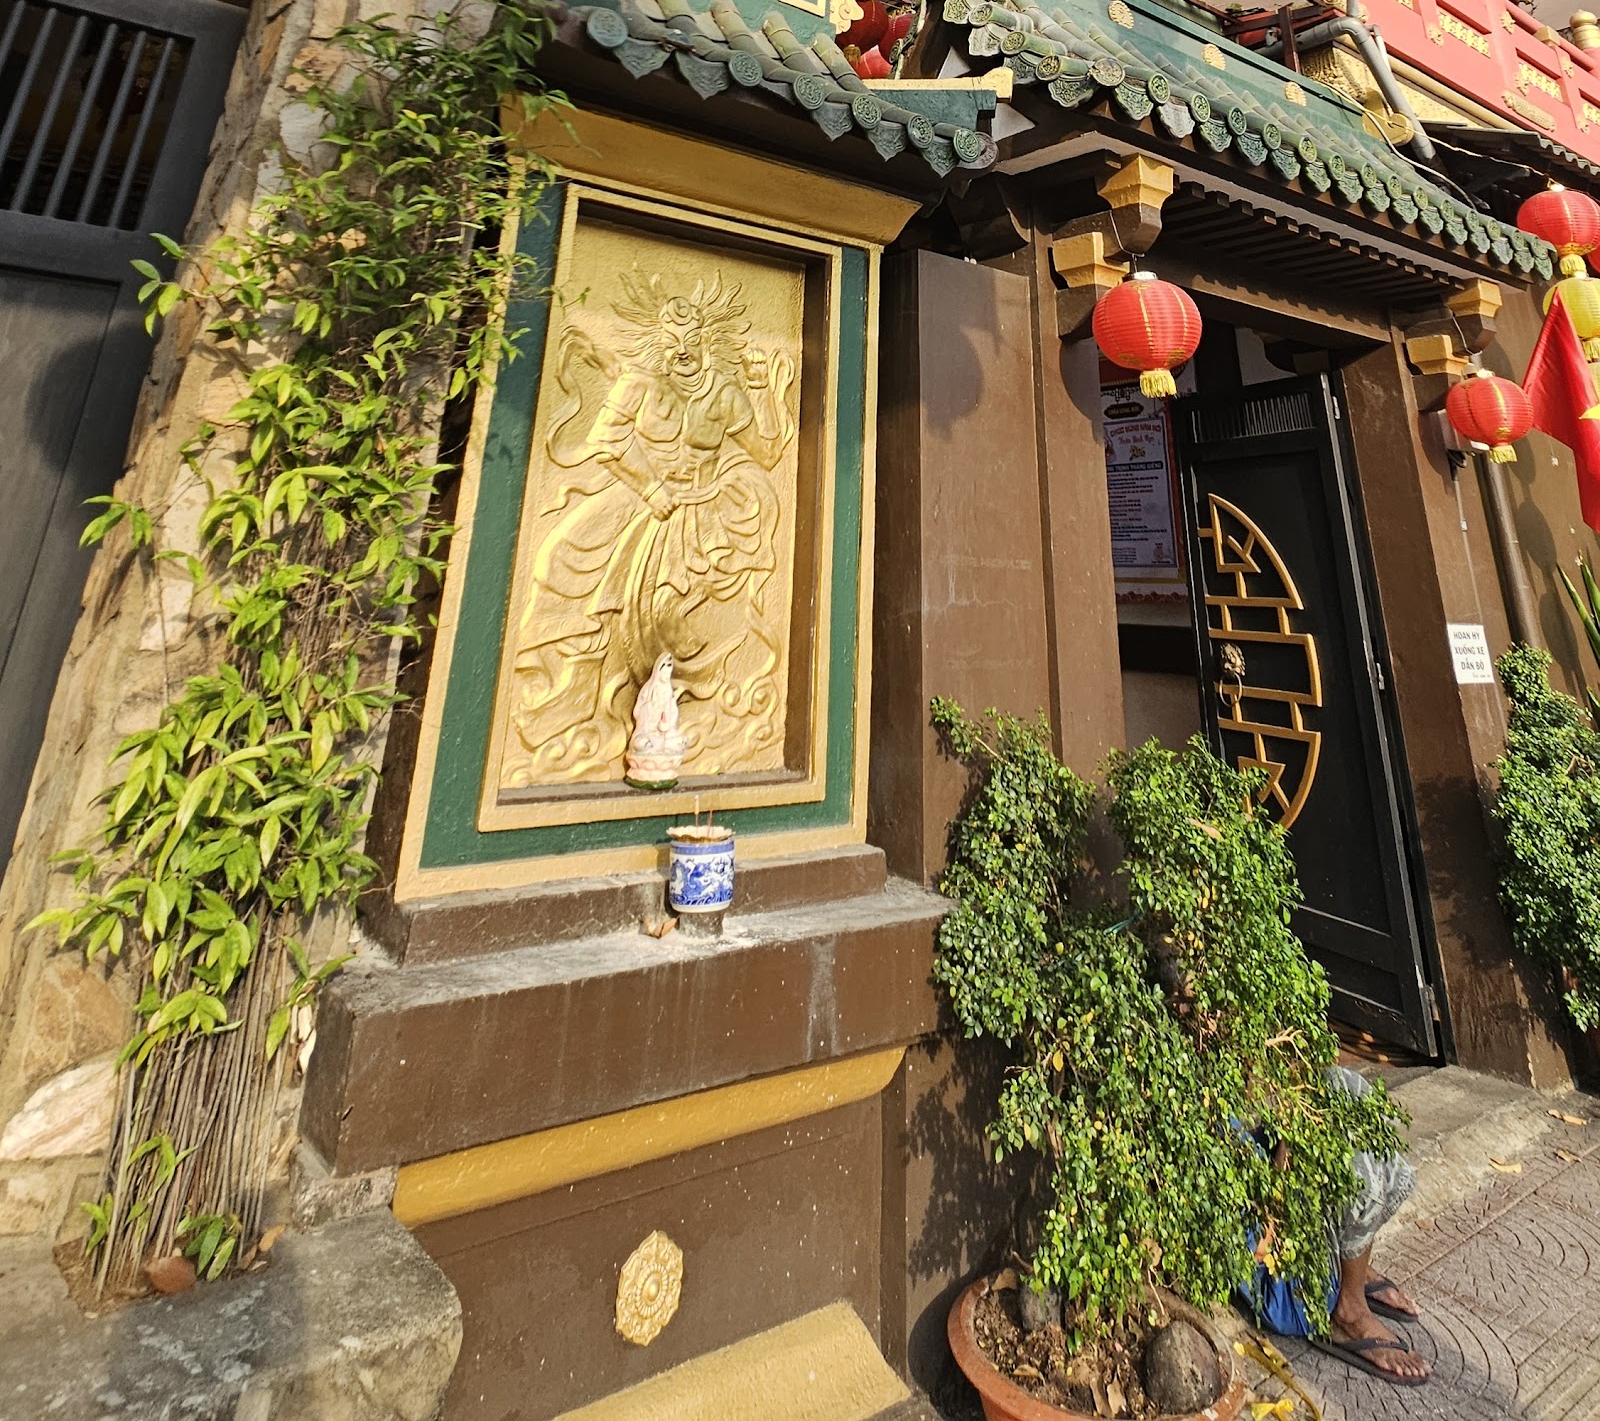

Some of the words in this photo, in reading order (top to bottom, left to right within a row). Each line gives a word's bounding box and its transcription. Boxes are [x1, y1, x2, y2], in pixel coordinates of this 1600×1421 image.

[1453, 631, 1471, 640] HOAN
[1454, 644, 1475, 655] XUỐNG
[1477, 646, 1485, 655] XE
